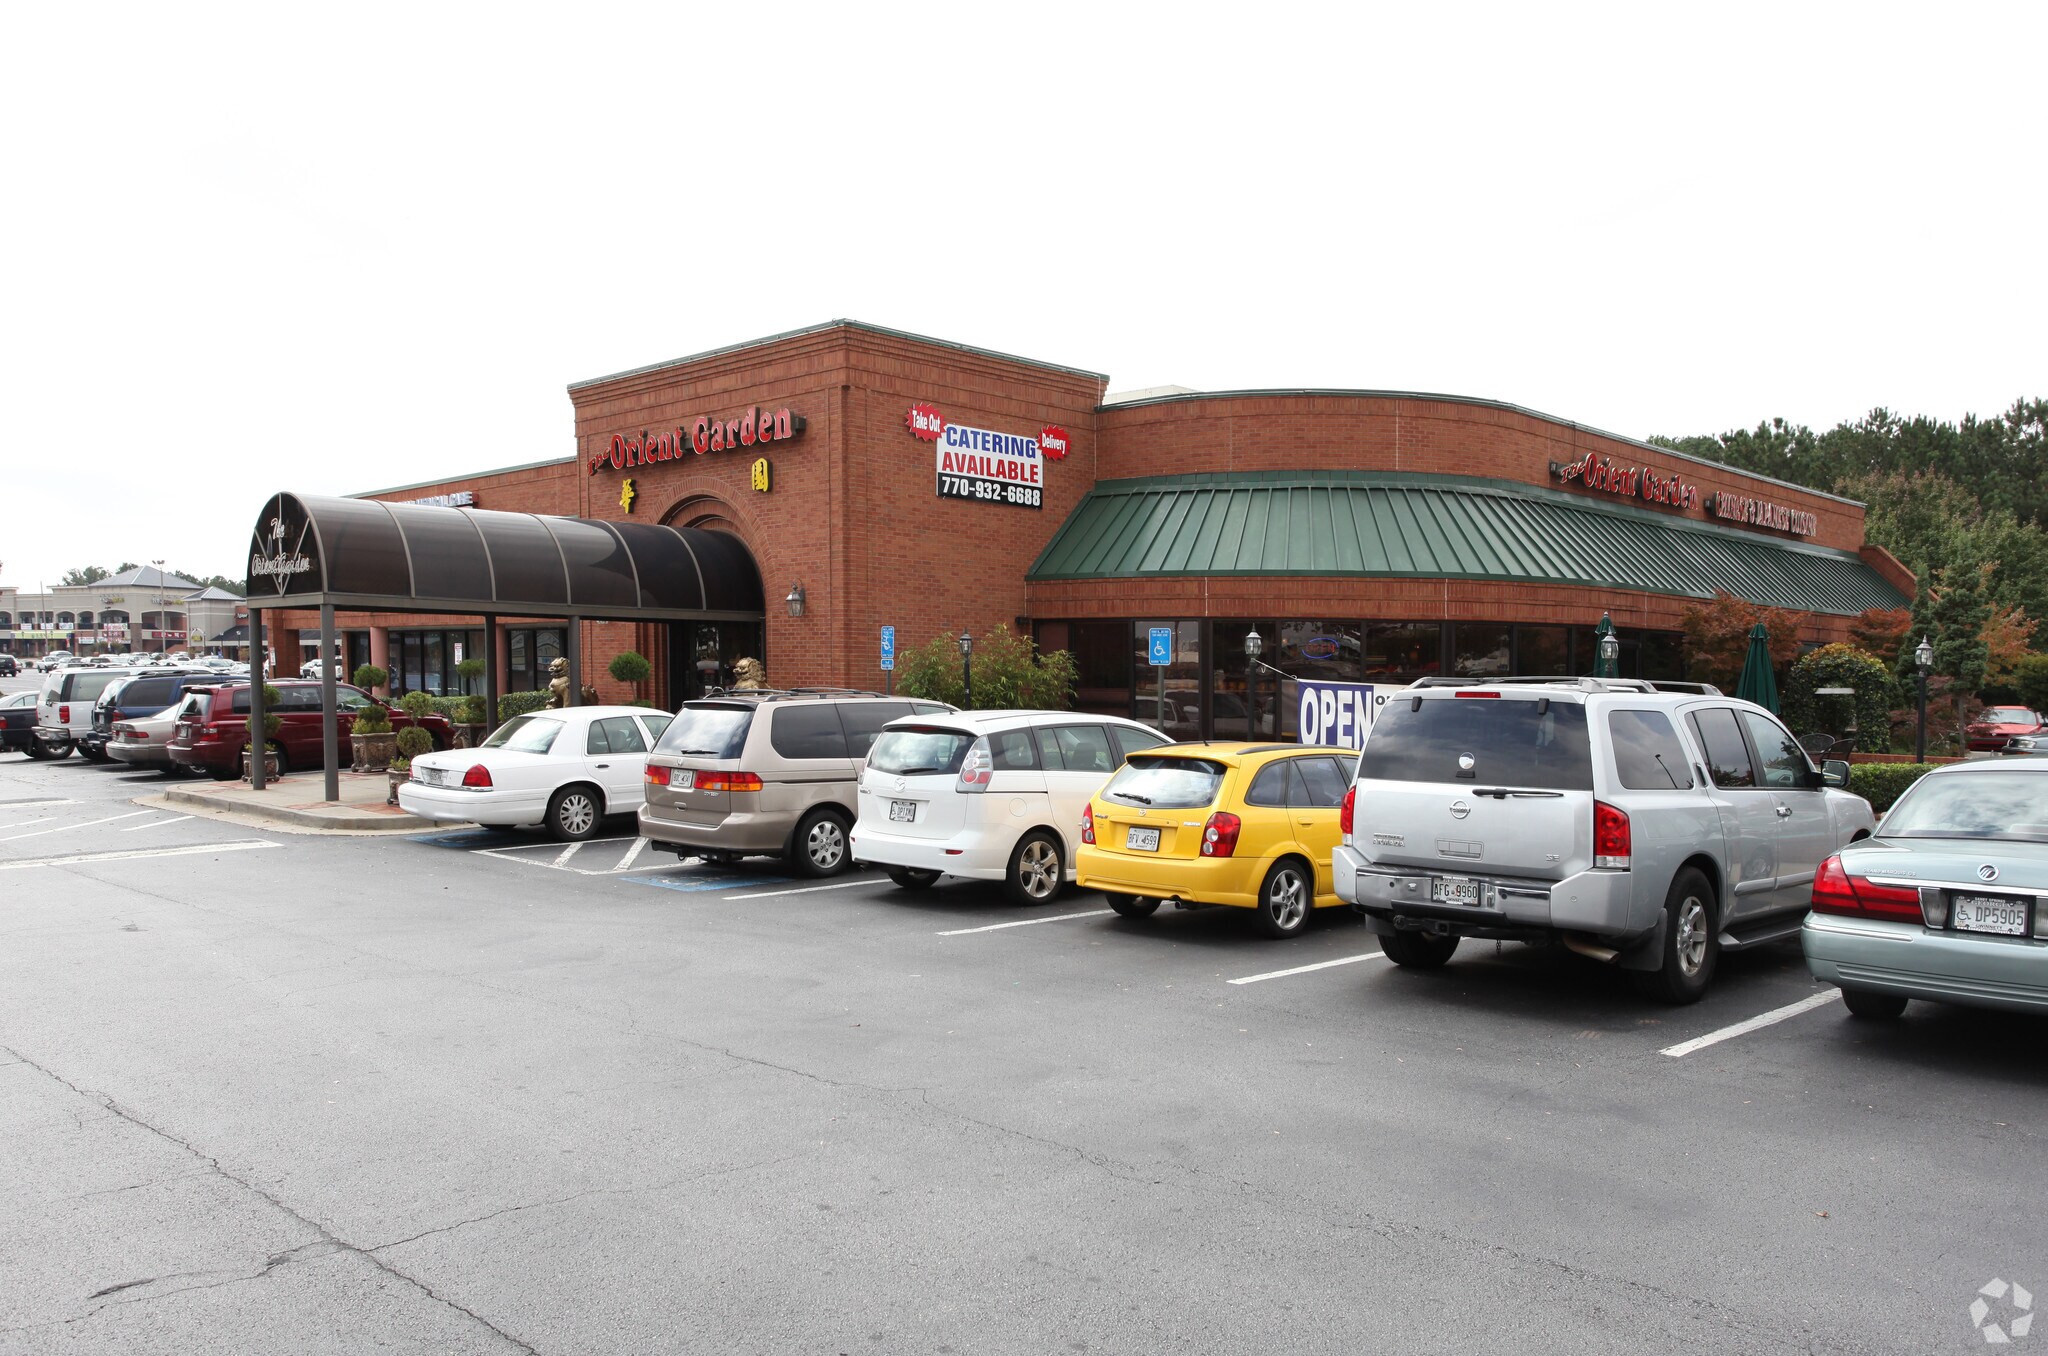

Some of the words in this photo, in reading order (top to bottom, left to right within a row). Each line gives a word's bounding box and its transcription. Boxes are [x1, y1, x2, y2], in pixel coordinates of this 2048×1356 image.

[912, 409, 928, 430] Take
[928, 413, 941, 433] Out
[610, 426, 683, 470] Orient
[692, 405, 793, 455] Garden
[946, 426, 1036, 459] CATERING
[1041, 433, 1067, 455] Delivery
[942, 451, 1039, 483] AVAILABLE
[1583, 452, 1637, 497] Orient
[1643, 467, 1698, 510] Garden
[942, 476, 1041, 506] 770-932-6688
[270, 517, 285, 540] The
[1301, 687, 1374, 751] OPEN
[1434, 883, 1450, 897] AFG
[1456, 884, 1478, 898] 9960
[1975, 906, 2024, 926] DP5905
